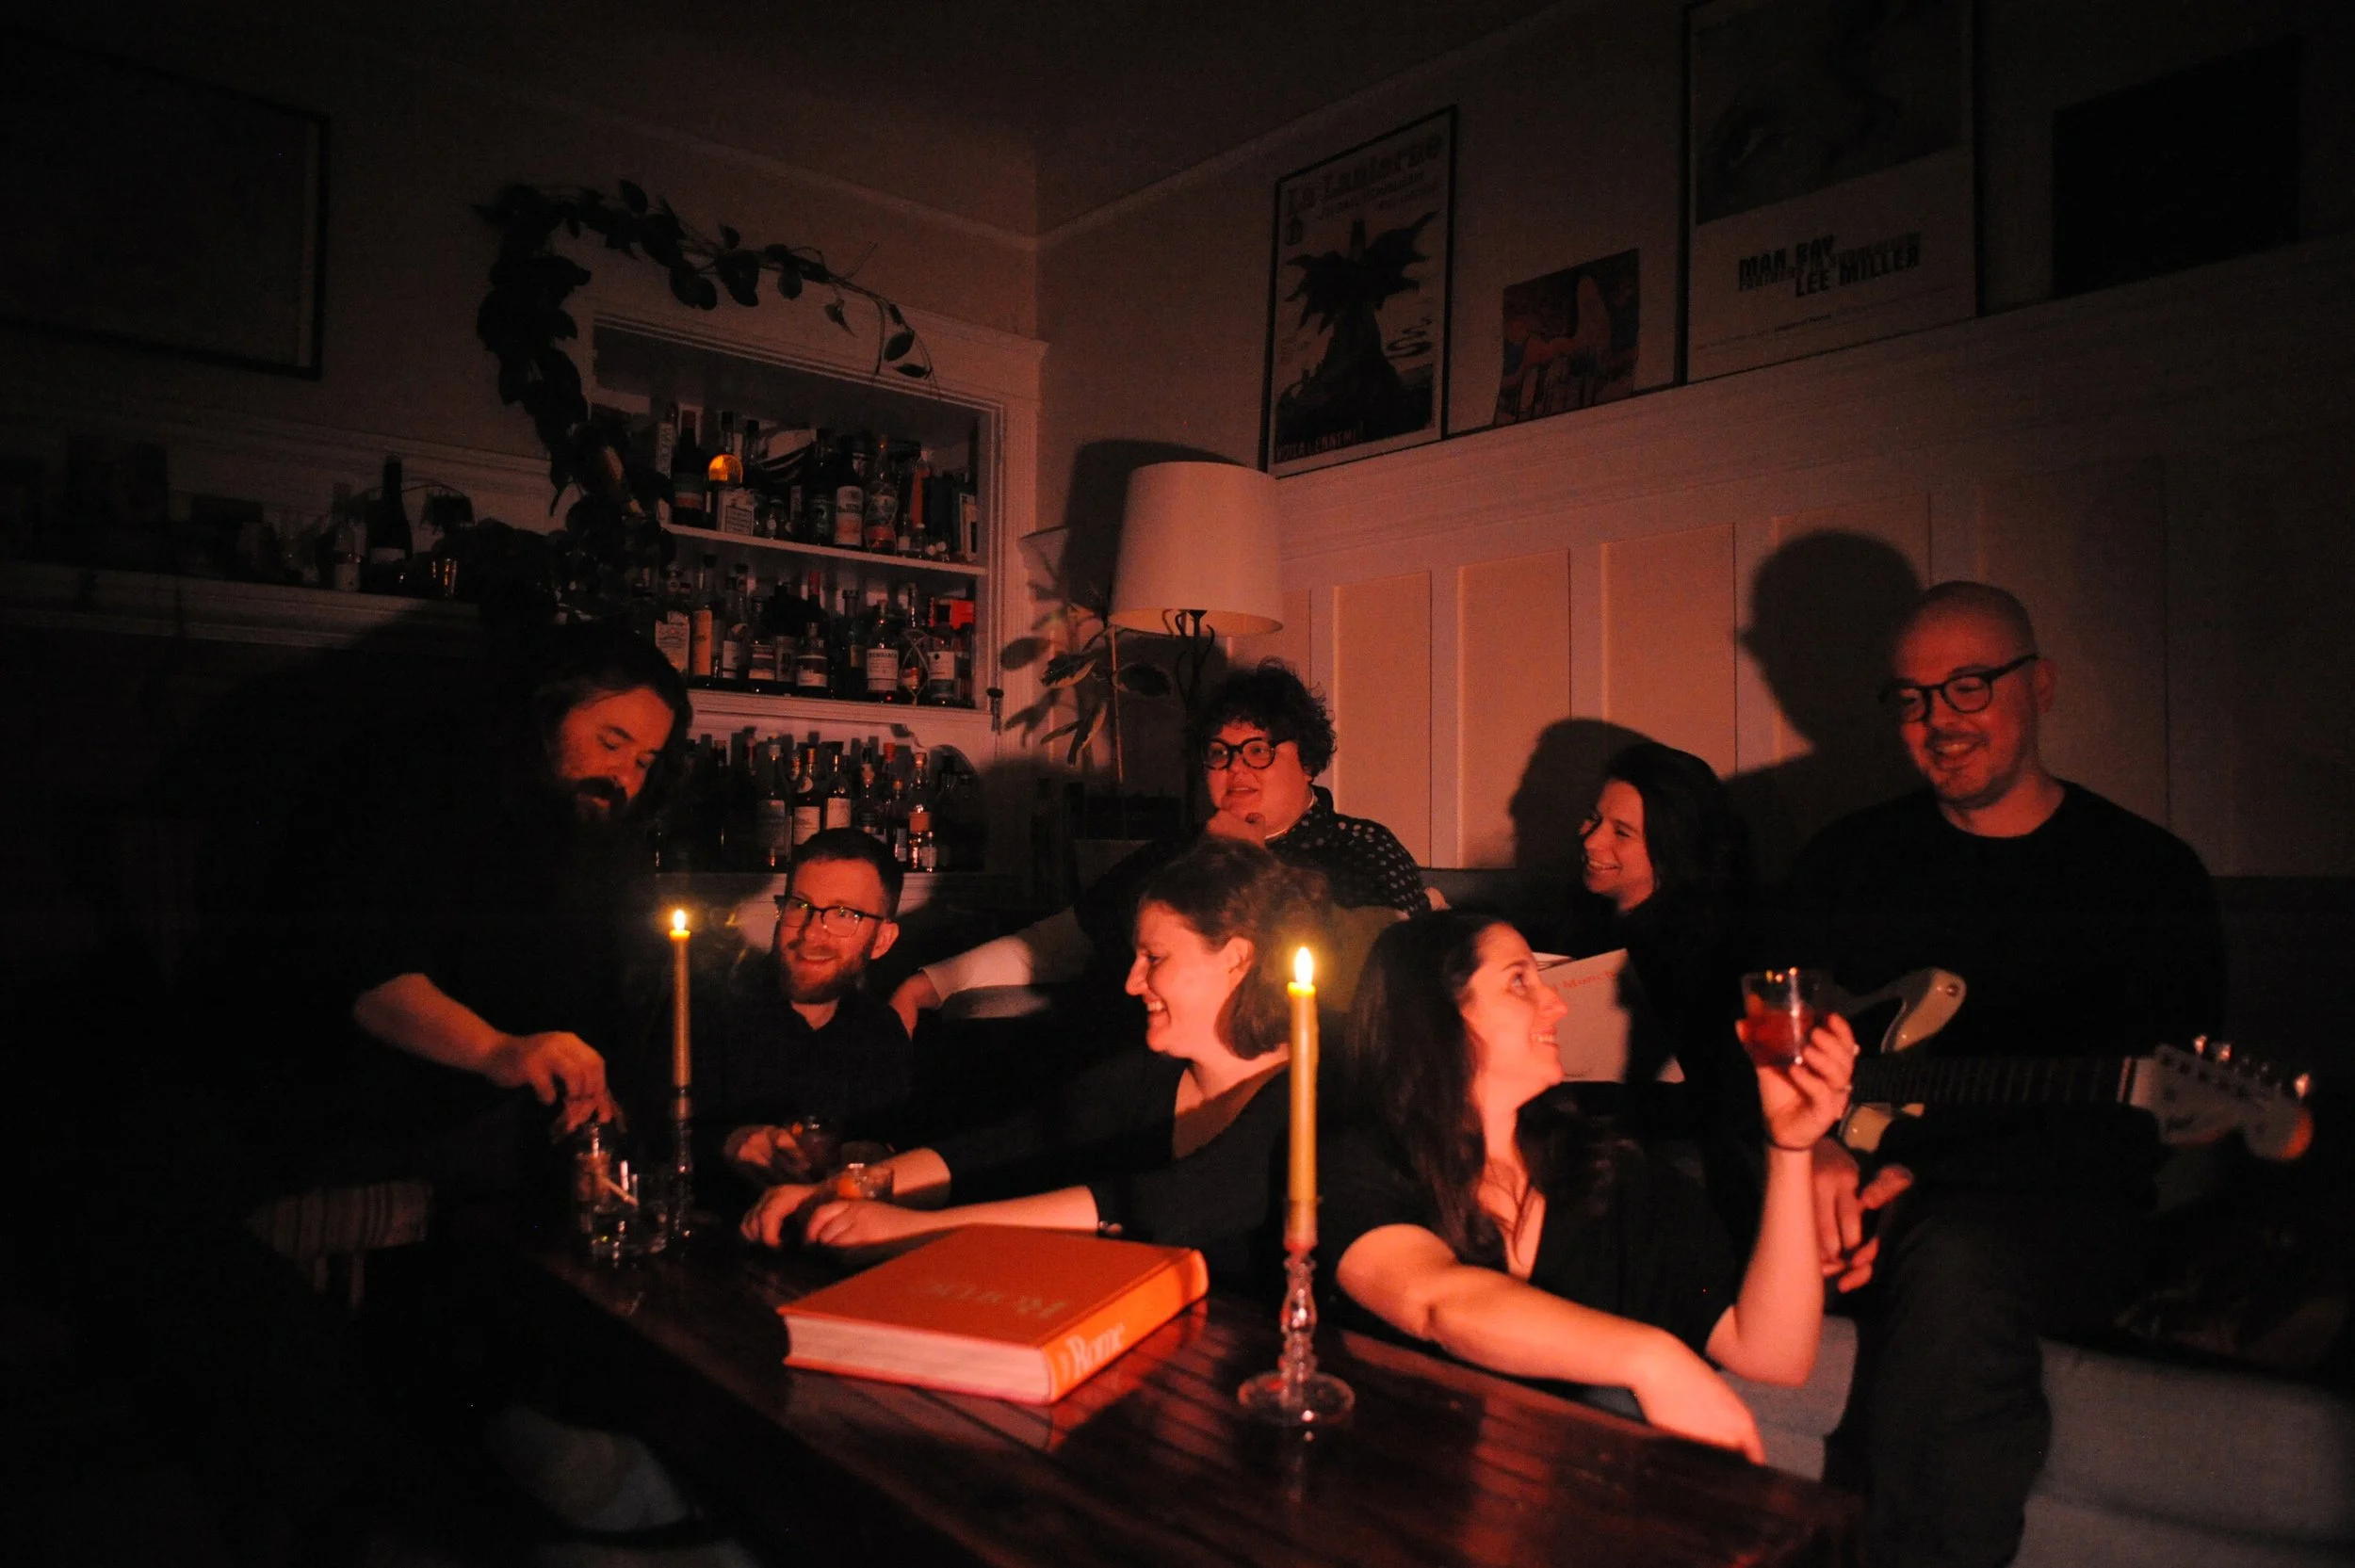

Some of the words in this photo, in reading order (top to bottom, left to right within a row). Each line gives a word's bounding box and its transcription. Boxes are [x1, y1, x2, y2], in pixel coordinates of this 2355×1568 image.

[1738, 248, 1786, 284] MAN
[1795, 234, 1835, 269] RAY
[1795, 267, 1830, 298] LEE
[1839, 243, 1922, 286] MILLER
